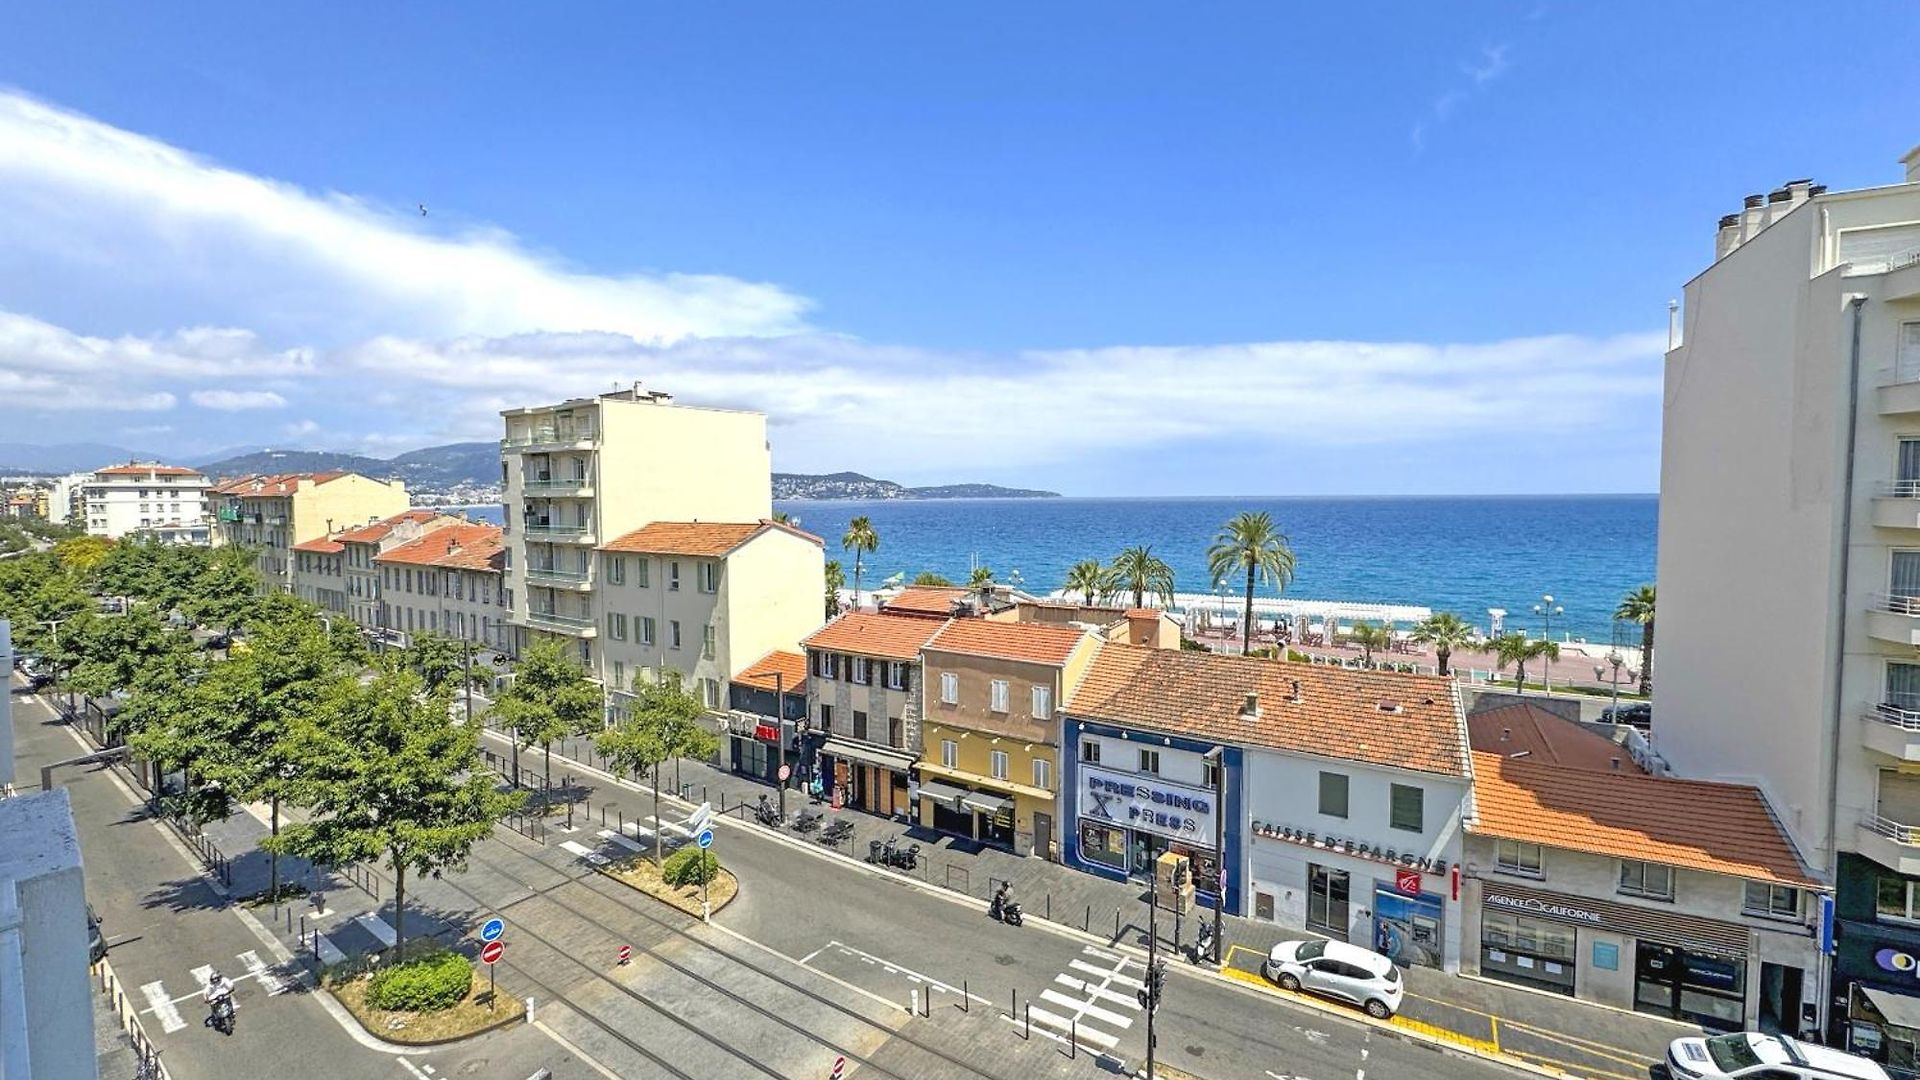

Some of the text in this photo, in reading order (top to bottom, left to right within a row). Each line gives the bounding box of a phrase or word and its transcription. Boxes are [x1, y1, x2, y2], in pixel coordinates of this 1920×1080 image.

[1089, 776, 1210, 815] PRESSING
[1128, 806, 1196, 832] PRESS
[1251, 820, 1316, 845] CAISSE
[1487, 895, 1601, 922] AGENCE CALIFORNIE
